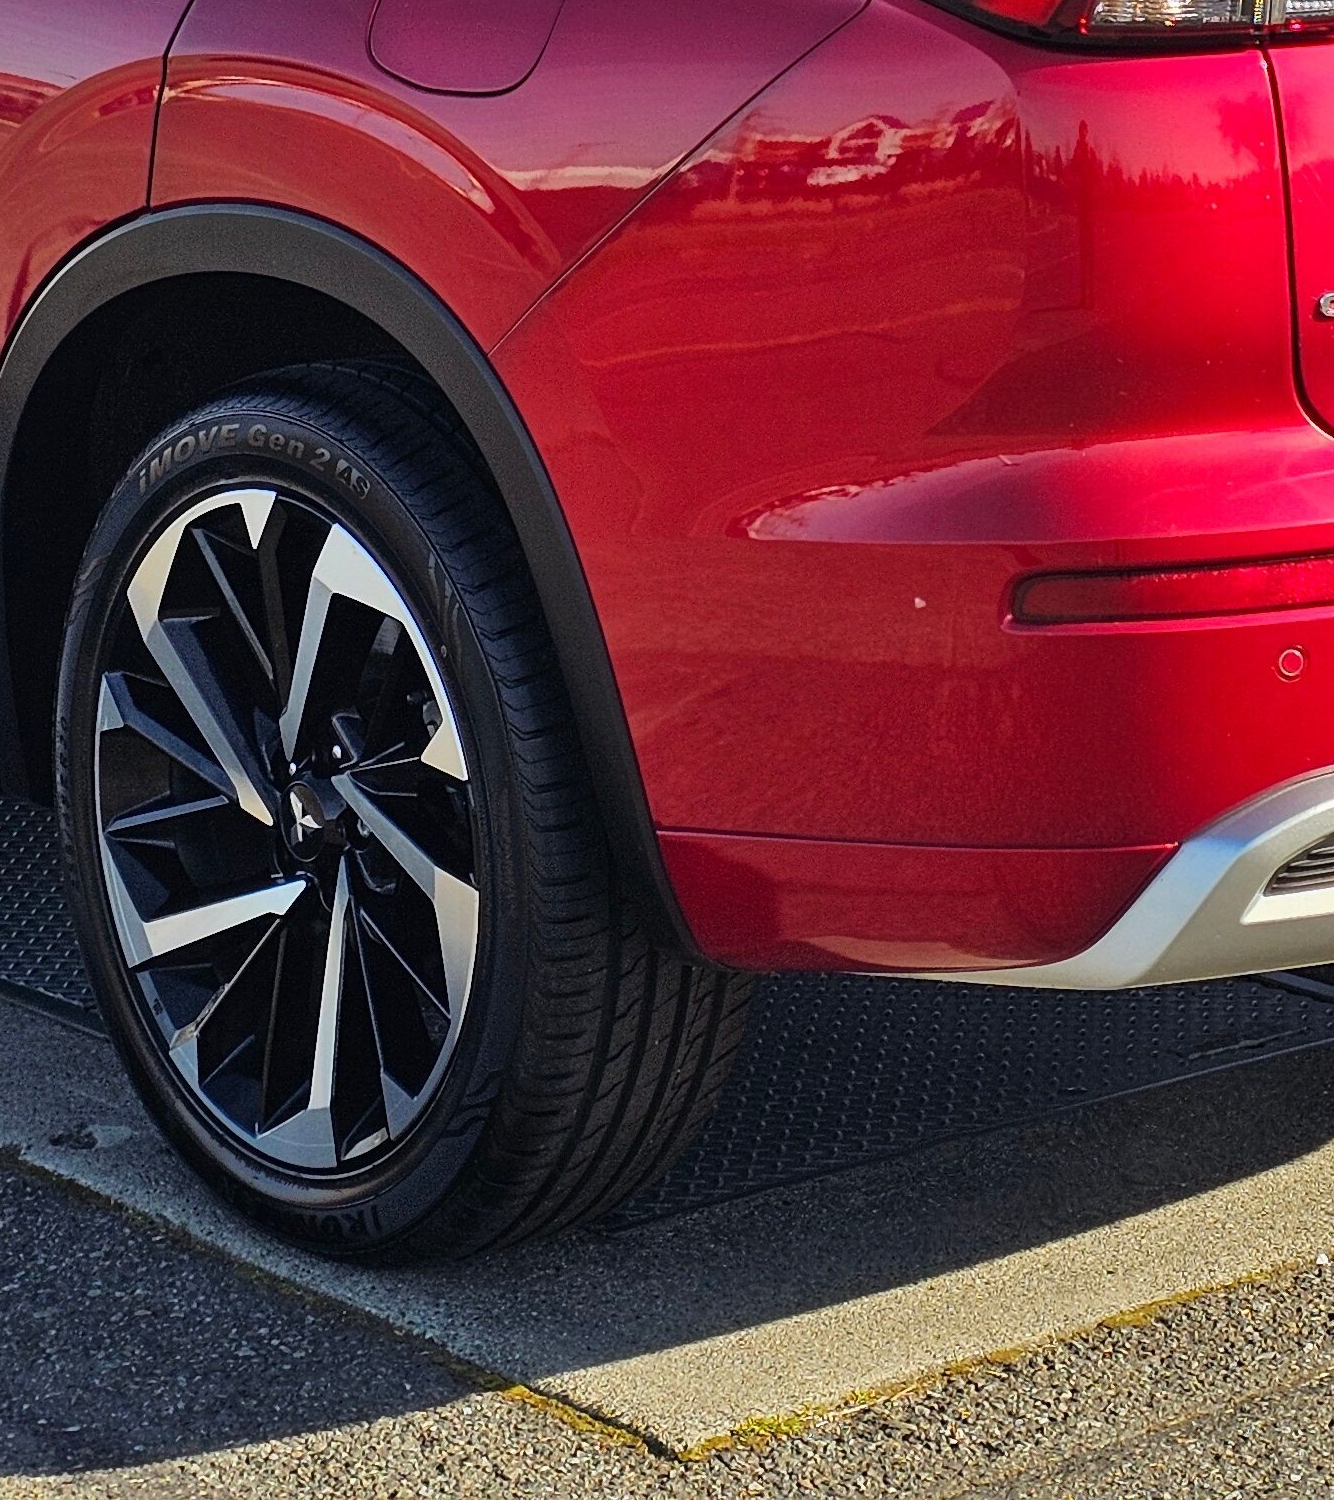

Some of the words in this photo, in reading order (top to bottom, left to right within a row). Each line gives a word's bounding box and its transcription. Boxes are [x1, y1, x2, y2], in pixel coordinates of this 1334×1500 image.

[138, 423, 241, 496] iMOVE
[247, 423, 305, 460] Gen
[310, 447, 332, 471] 2
